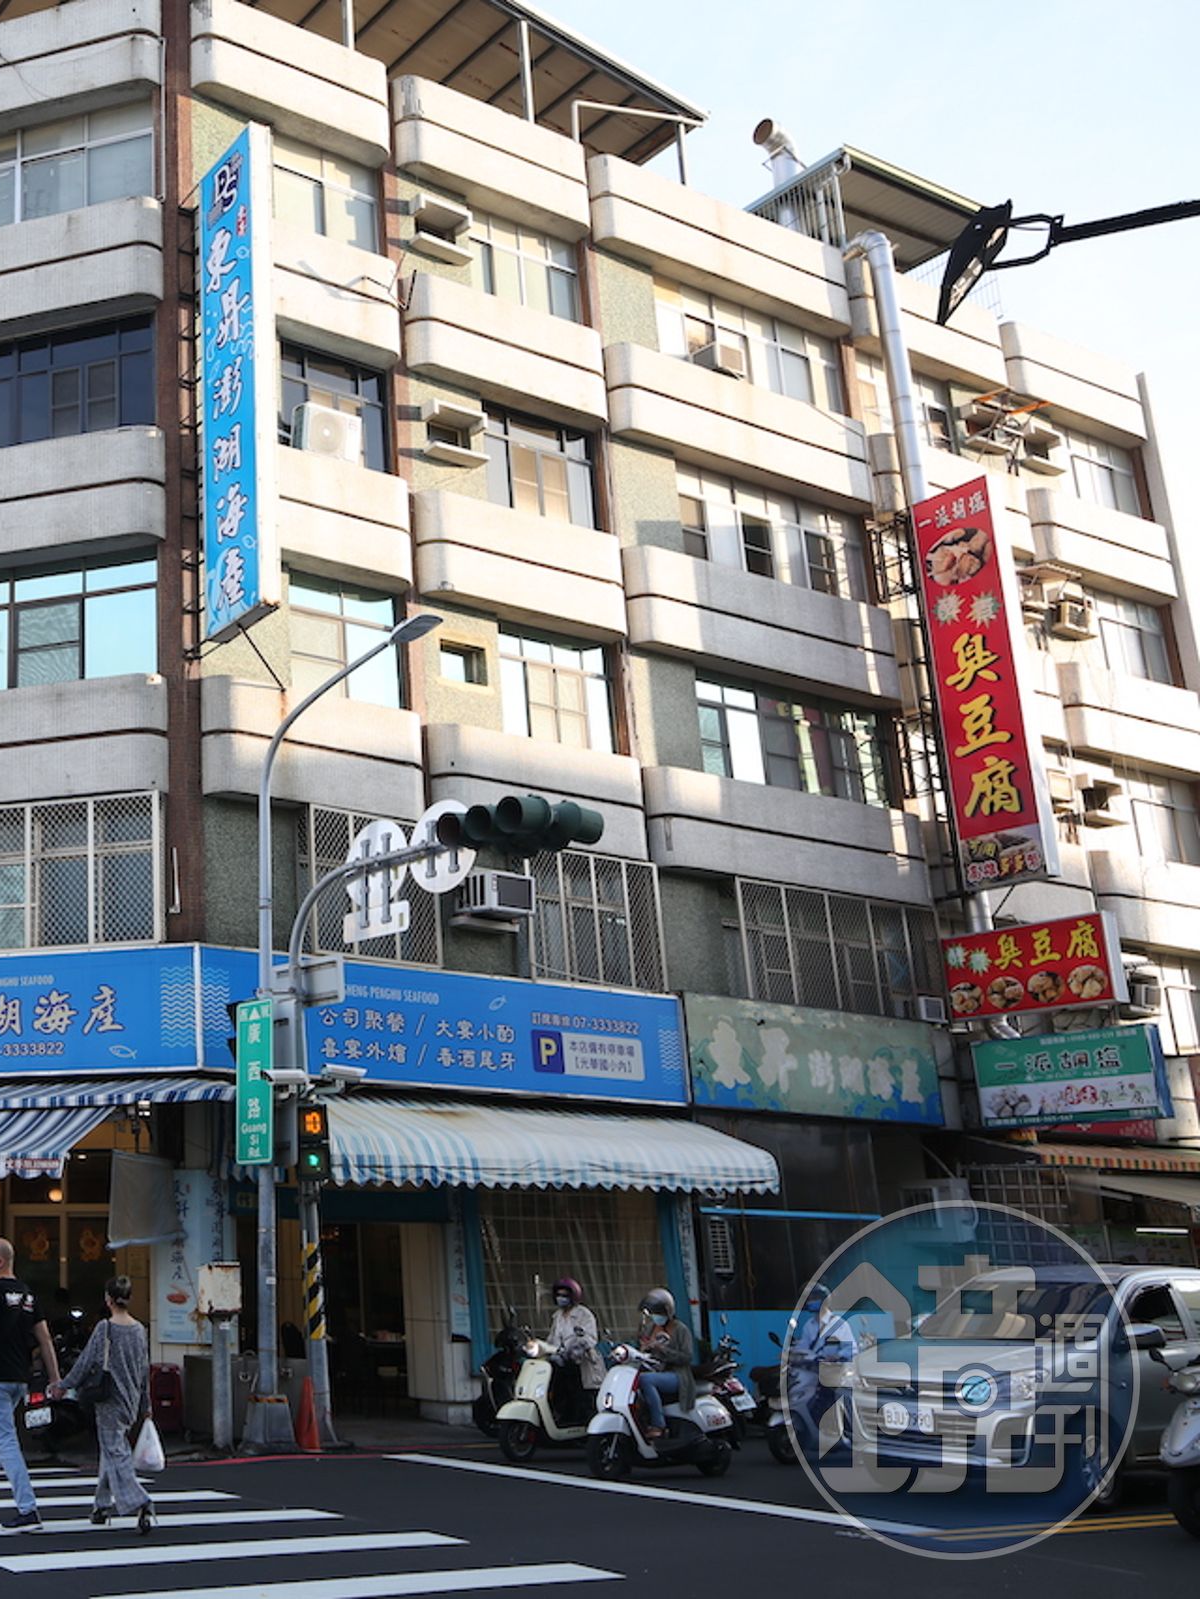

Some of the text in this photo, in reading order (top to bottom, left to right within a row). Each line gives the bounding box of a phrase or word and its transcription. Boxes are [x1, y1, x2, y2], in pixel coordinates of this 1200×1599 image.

[945, 632, 1021, 818] 臭豆腐
[994, 921, 1100, 971] 臭豆腐
[318, 1007, 406, 1034] 公司聚餐
[436, 1018, 515, 1044] 大宴小酌
[572, 1016, 640, 1035] 07-3333822
[321, 1038, 407, 1064] 喜宴外燴
[436, 1046, 517, 1072] 春酒尾牙
[539, 1037, 557, 1066] P
[241, 1123, 267, 1135] Guang
[249, 1135, 260, 1146] Si
